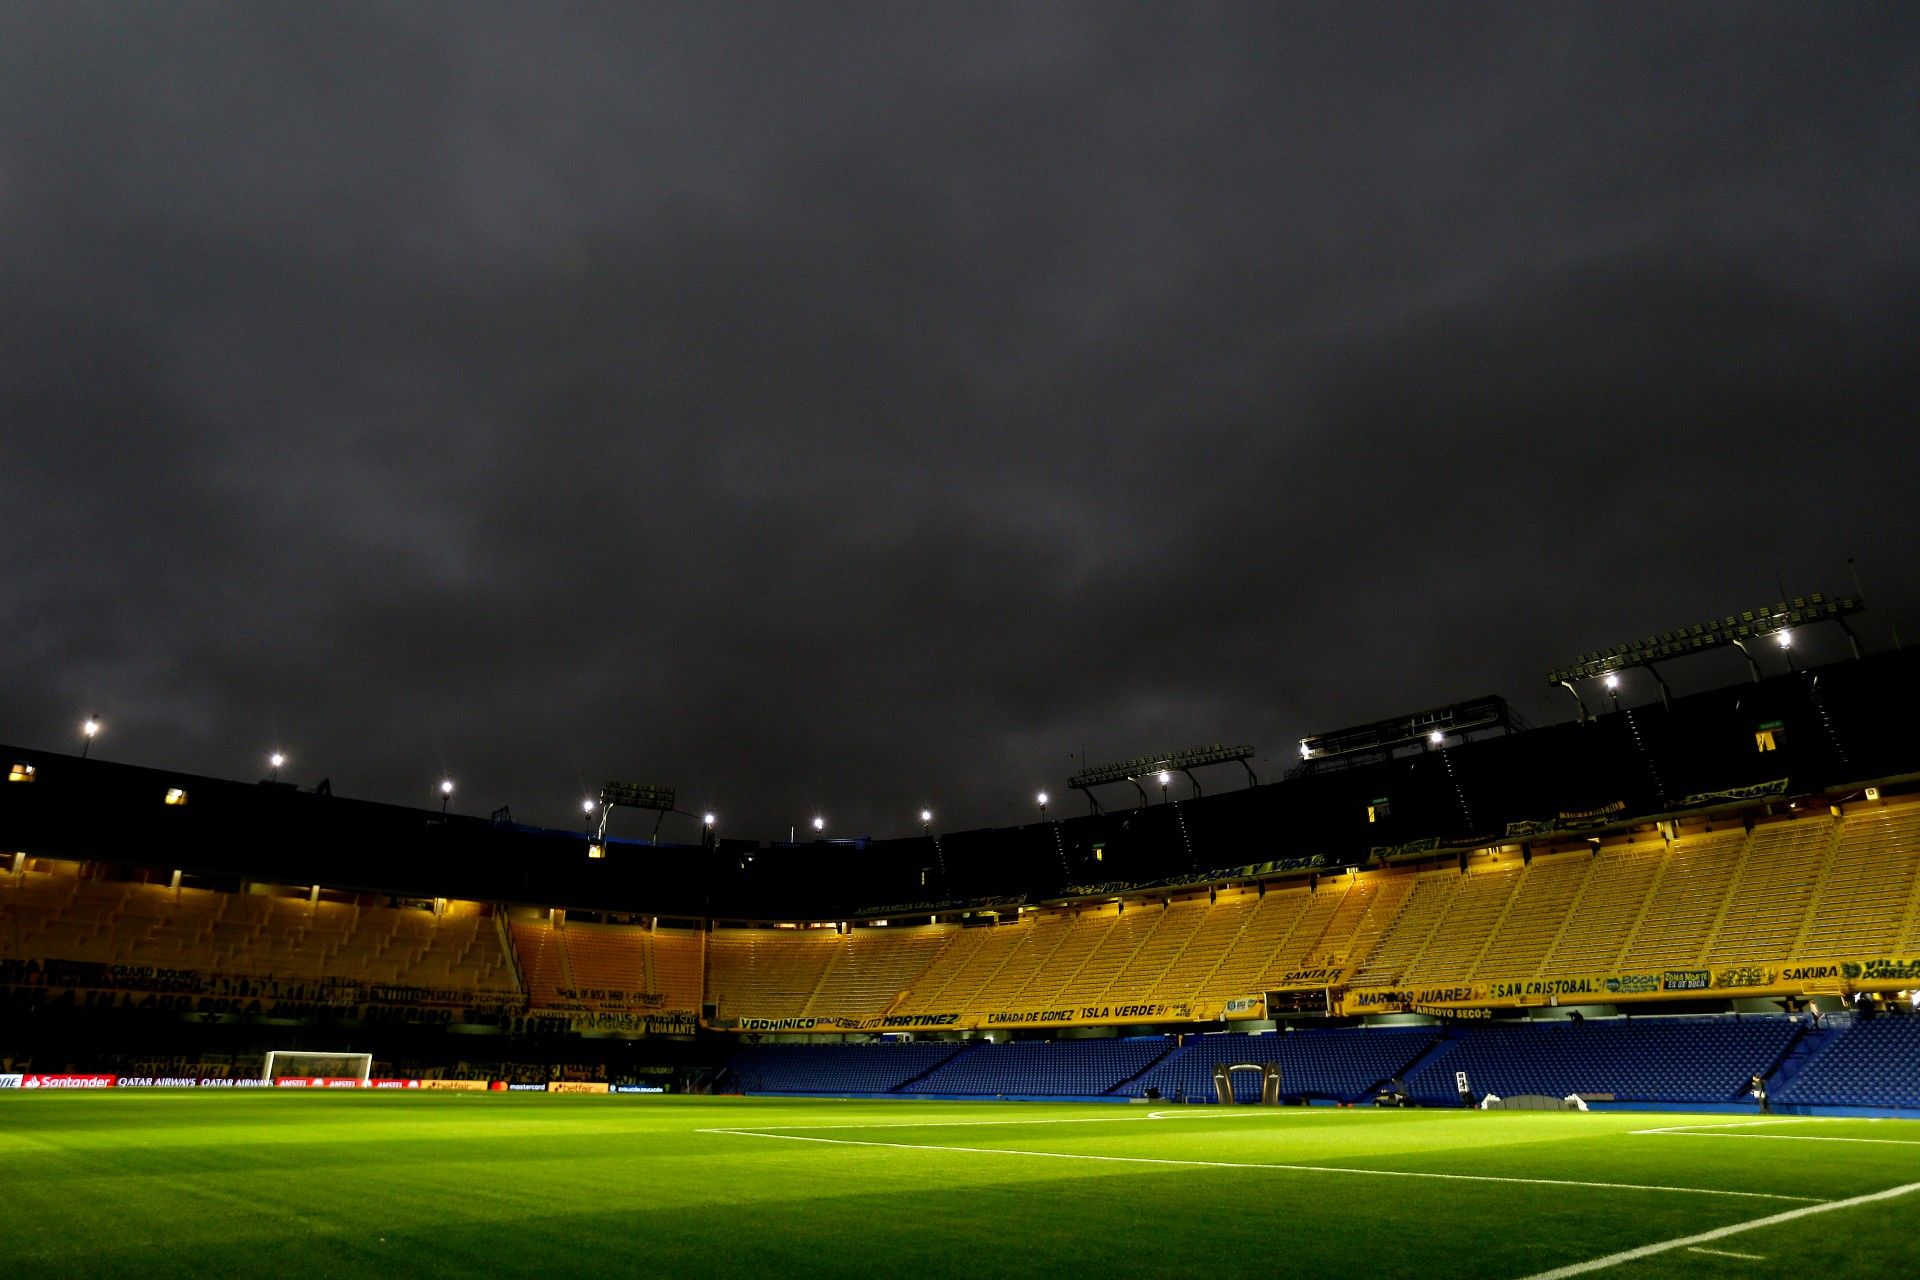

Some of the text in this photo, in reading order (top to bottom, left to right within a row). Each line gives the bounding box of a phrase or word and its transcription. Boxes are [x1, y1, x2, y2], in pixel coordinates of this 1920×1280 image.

[1283, 969, 1327, 981] SANTA
[1664, 973, 1684, 982] ZONA
[1783, 965, 1838, 980] SAKURA
[1498, 982, 1522, 998] SAN
[1526, 978, 1593, 995] CRISTOBAL
[1667, 980, 1706, 989] ES DE BOCA
[1417, 987, 1473, 1003] JUAREZ
[988, 1009, 1075, 1024] CAÑADA DE GOMEZ
[1081, 1007, 1110, 1019] ISLA
[1115, 1004, 1157, 1017] VERDE
[1416, 1006, 1482, 1019] ARROYO SECO
[882, 1014, 959, 1027] MARTINEZ
[41, 1075, 111, 1088] Santander
[117, 1077, 197, 1088] QATAR AIRWAYS
[201, 1078, 274, 1088] QATAR AIRWAYS
[280, 1079, 307, 1088] AMSTEL
[330, 1080, 356, 1088] AMSTEL
[377, 1081, 403, 1089] AMSTEL
[437, 1080, 470, 1090] betfair
[509, 1083, 546, 1091] mastercard
[563, 1082, 593, 1092] betfair
